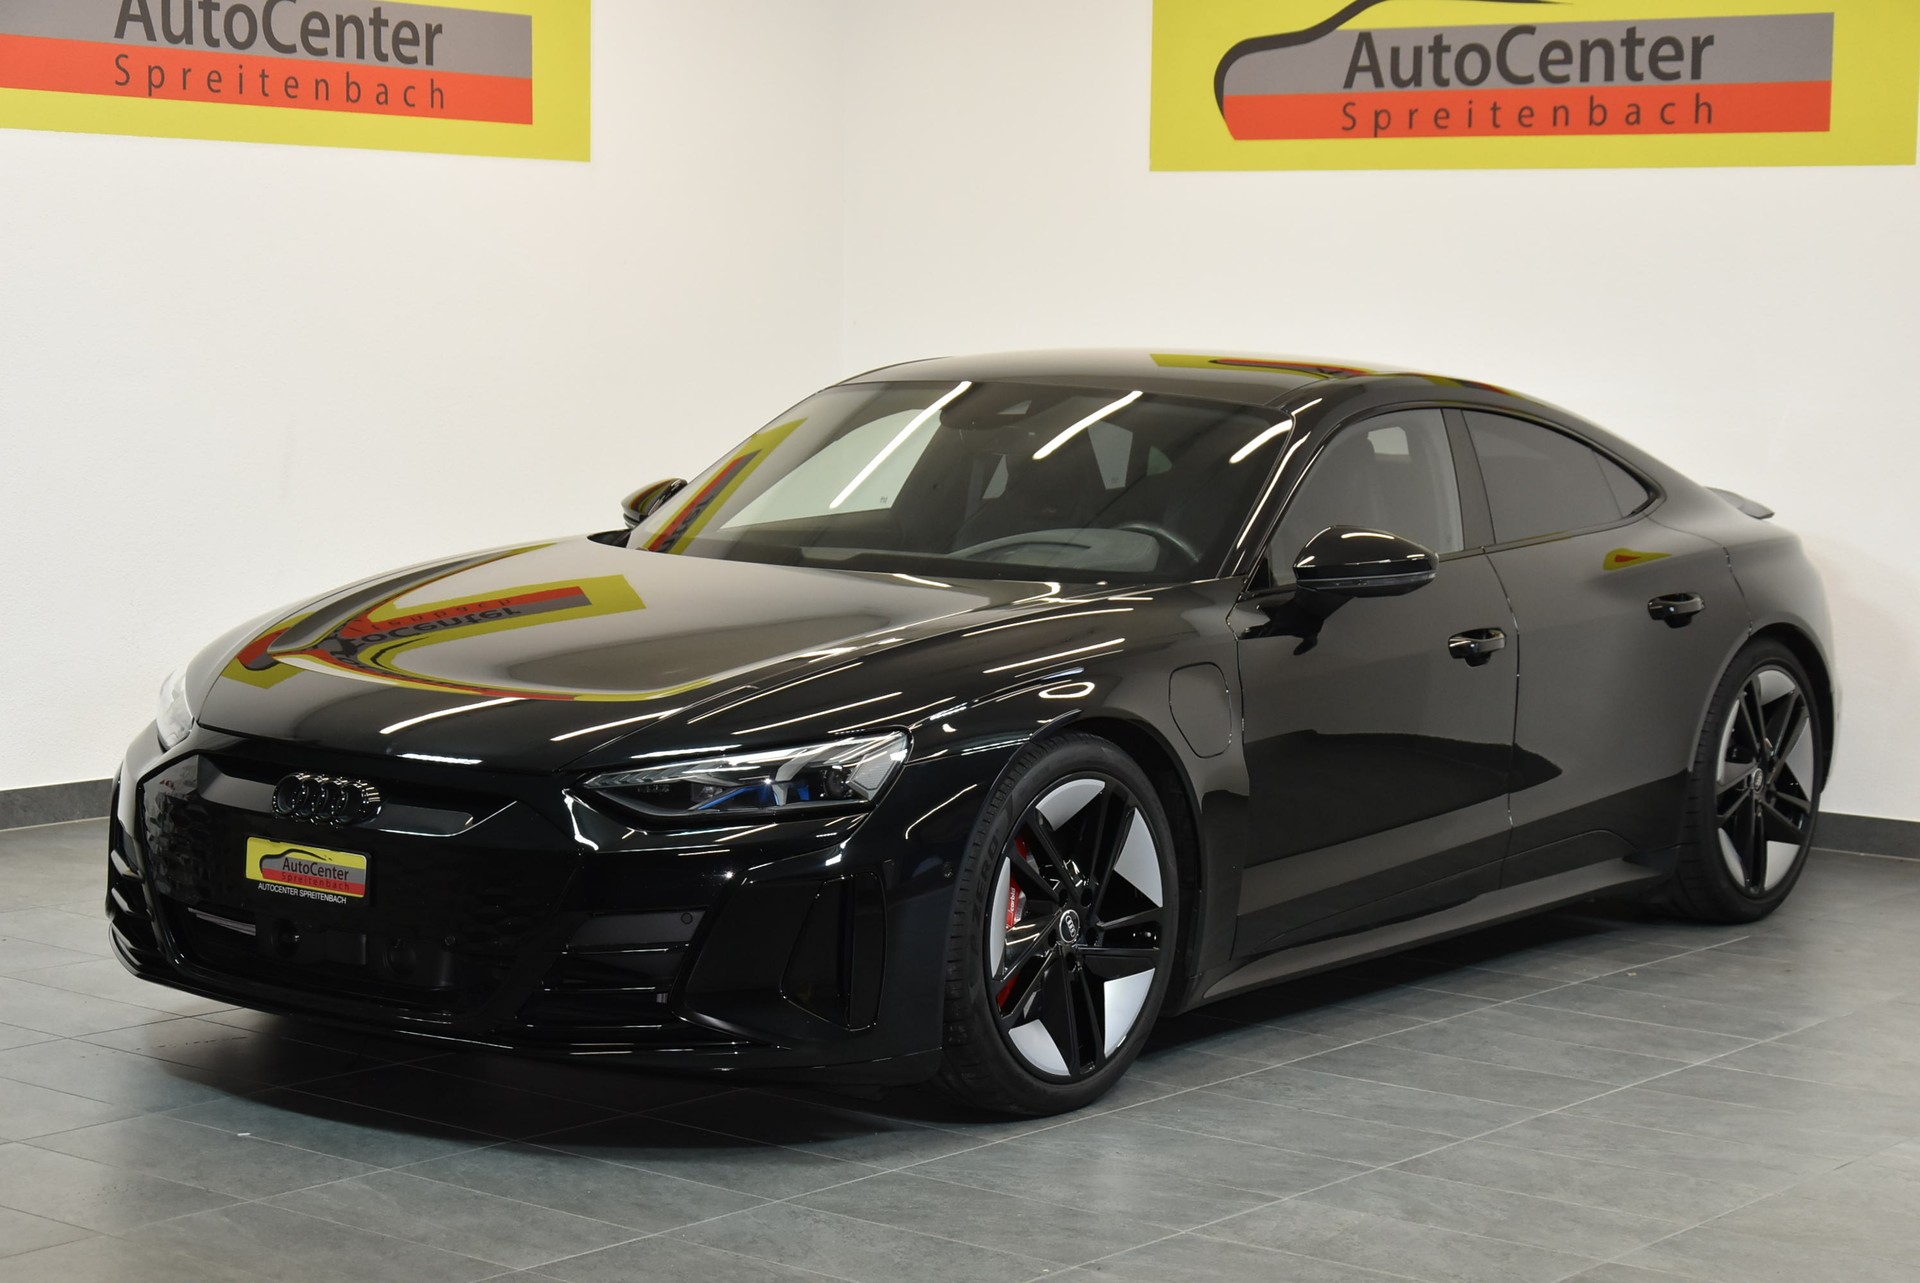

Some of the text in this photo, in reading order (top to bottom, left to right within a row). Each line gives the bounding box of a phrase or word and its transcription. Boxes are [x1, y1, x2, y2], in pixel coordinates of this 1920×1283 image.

[114, 0, 443, 66] AutoCenter
[1342, 25, 1715, 89] AutoCenter
[114, 54, 445, 109] Spreitenbach
[1342, 94, 1714, 138] Spreitenbach
[281, 872, 350, 891] Spreitenbach
[282, 857, 349, 881] AutoCenter
[258, 882, 347, 904] AUTOCENTER SPREITENBACH
